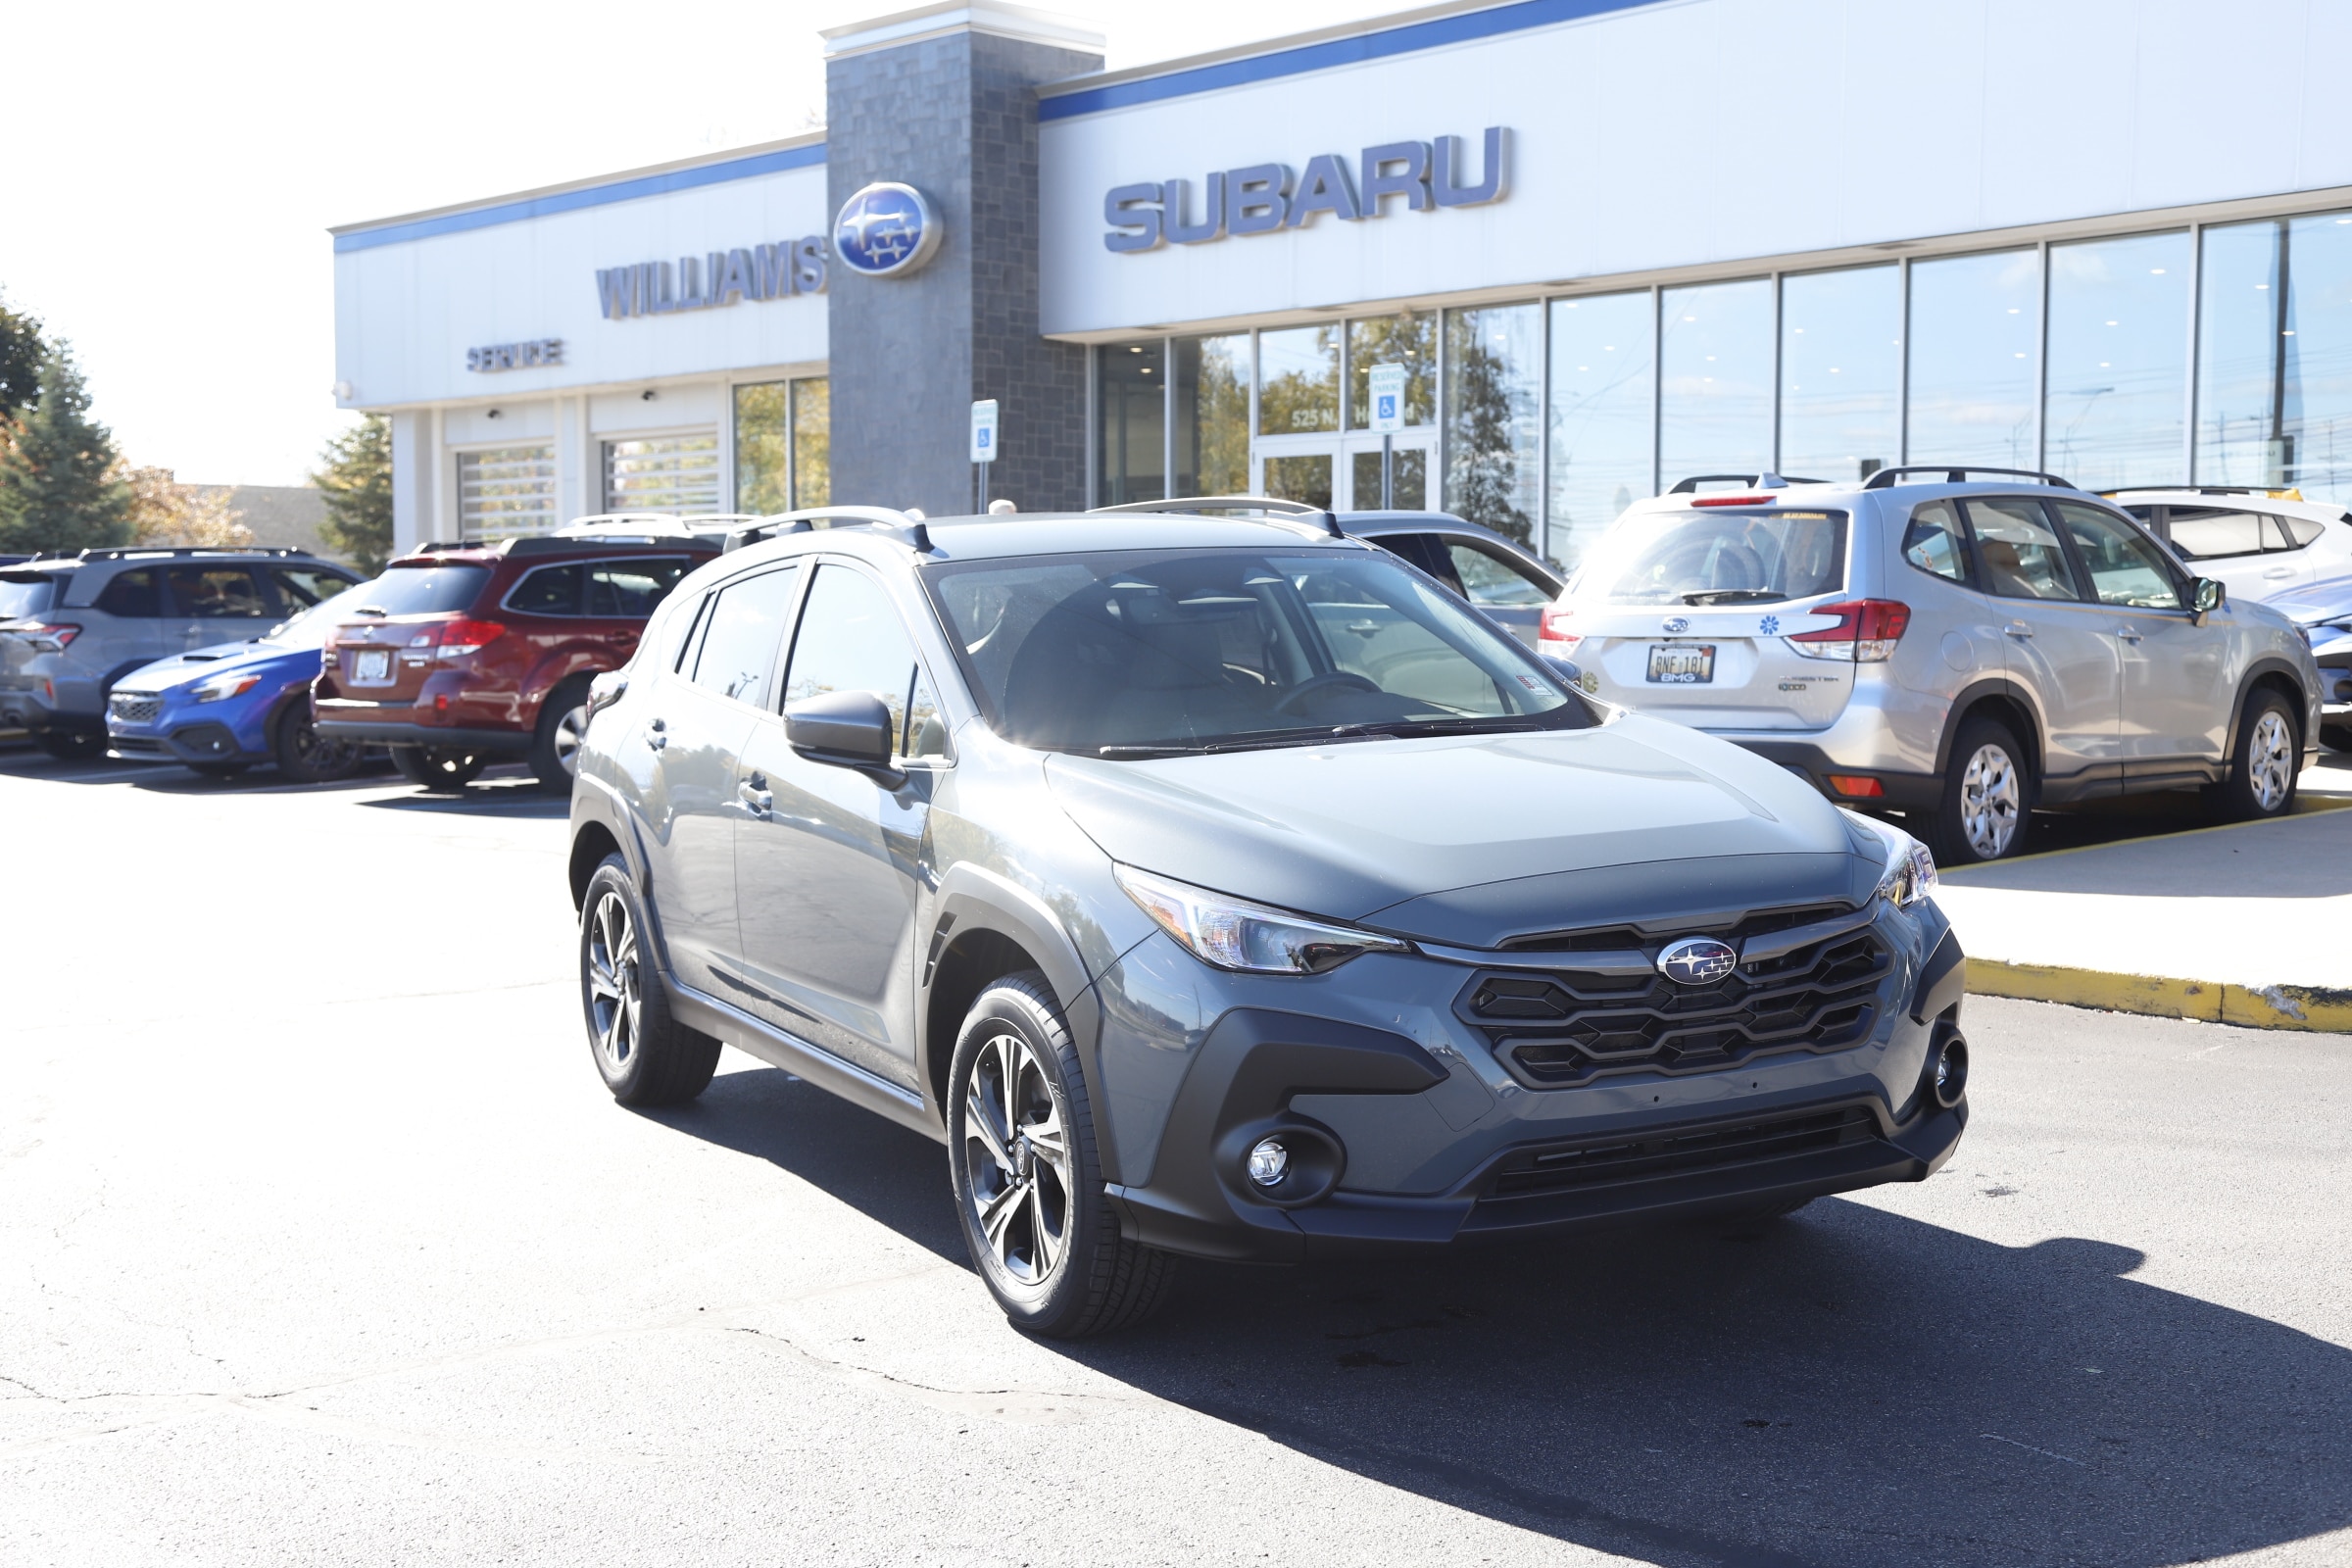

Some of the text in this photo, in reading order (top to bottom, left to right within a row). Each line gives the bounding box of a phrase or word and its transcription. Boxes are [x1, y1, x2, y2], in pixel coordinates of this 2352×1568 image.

[1104, 126, 1511, 254] SUBARU
[596, 235, 828, 319] WILLIAMS
[467, 338, 564, 372] SERVICE
[1292, 409, 1318, 427] 525
